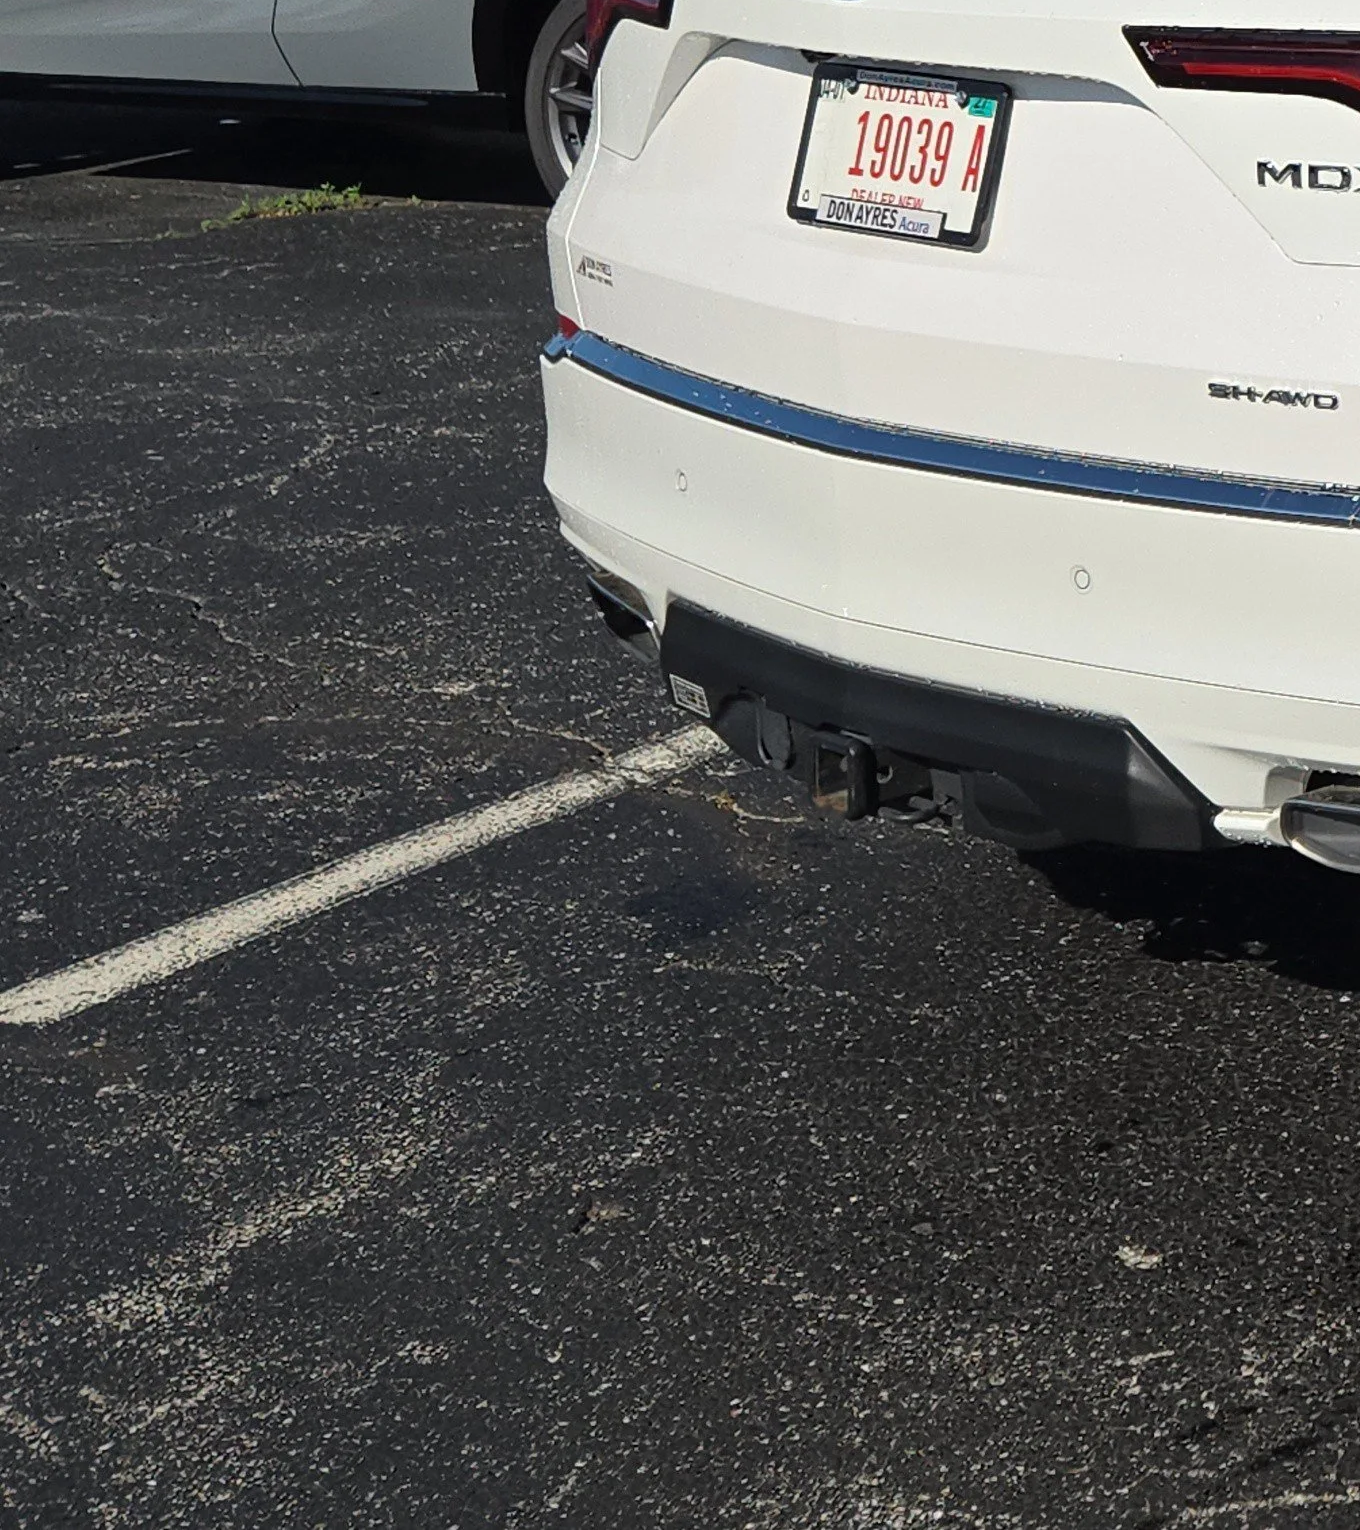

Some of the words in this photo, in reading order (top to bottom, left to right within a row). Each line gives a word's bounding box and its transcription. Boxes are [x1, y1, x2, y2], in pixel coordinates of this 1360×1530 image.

[863, 83, 950, 109] INDIANA
[847, 110, 954, 188] 19039
[961, 124, 986, 192] A
[826, 199, 855, 221] DON
[854, 206, 900, 230] AYRES
[898, 216, 932, 234] Acura
[1207, 382, 1340, 410] SH-AWD
